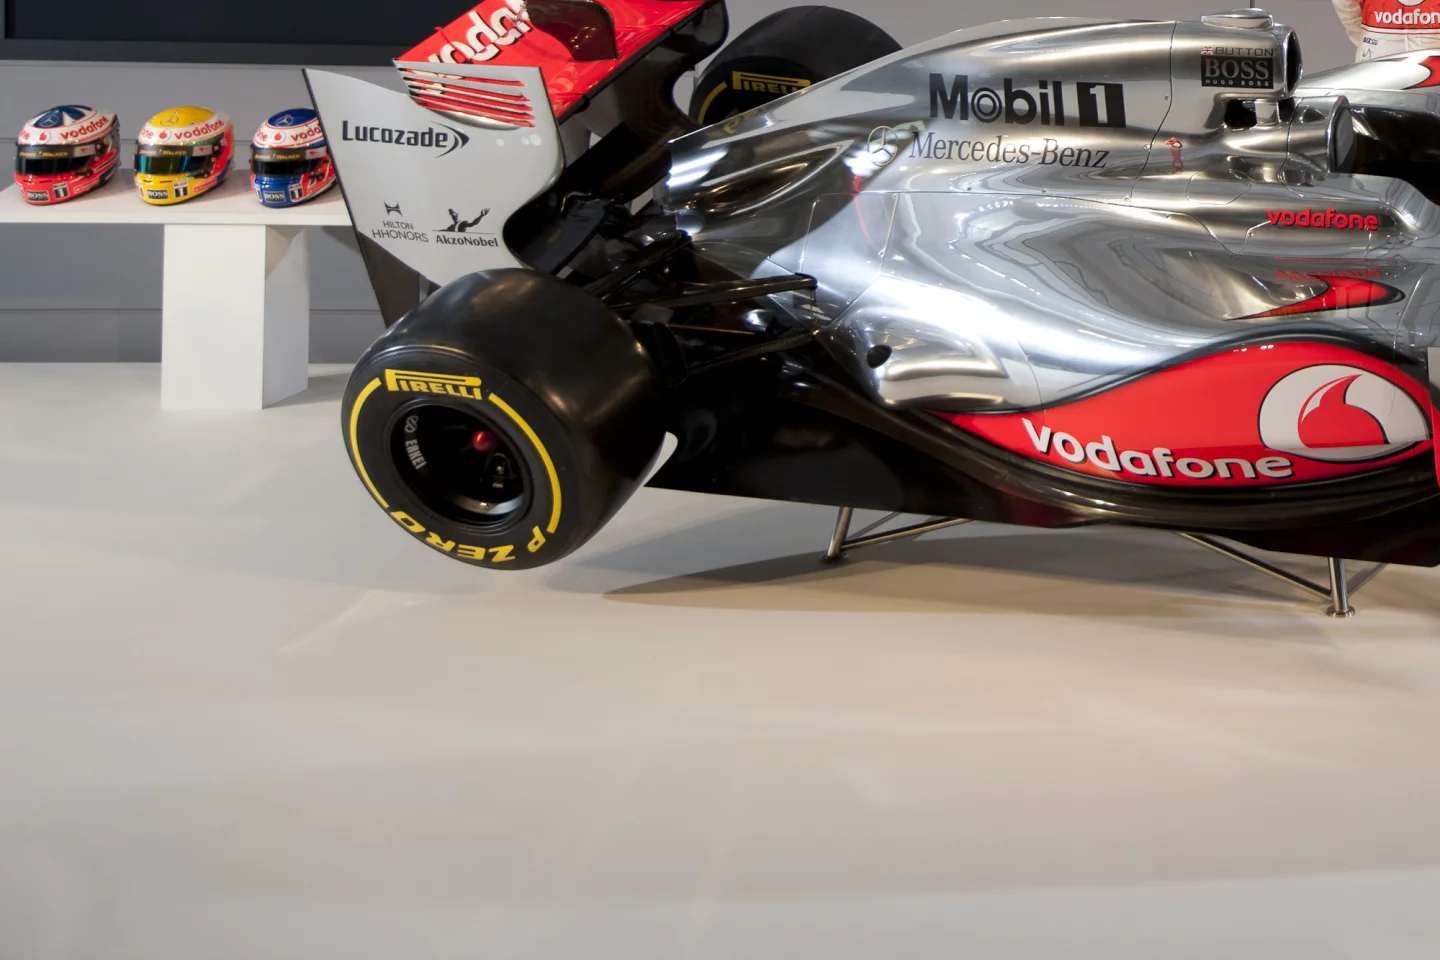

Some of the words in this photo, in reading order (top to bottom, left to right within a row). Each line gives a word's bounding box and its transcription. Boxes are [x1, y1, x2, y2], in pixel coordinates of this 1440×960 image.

[1214, 46, 1275, 57] BUTTON
[1205, 58, 1270, 80] BOSS
[928, 73, 1064, 126] Mobil
[342, 120, 448, 148] Lucozade
[908, 131, 1111, 169] Mercedes-Benz
[382, 220, 414, 230] HILTON
[1266, 207, 1379, 231] vodafone
[371, 229, 429, 243] HHONORS
[435, 235, 499, 247] AkzoNobel
[384, 368, 482, 401] PIRELLI
[405, 439, 427, 470] ENKEI
[1021, 417, 1296, 480] vodafone
[390, 510, 516, 563] ZERO
[527, 525, 547, 553] P
